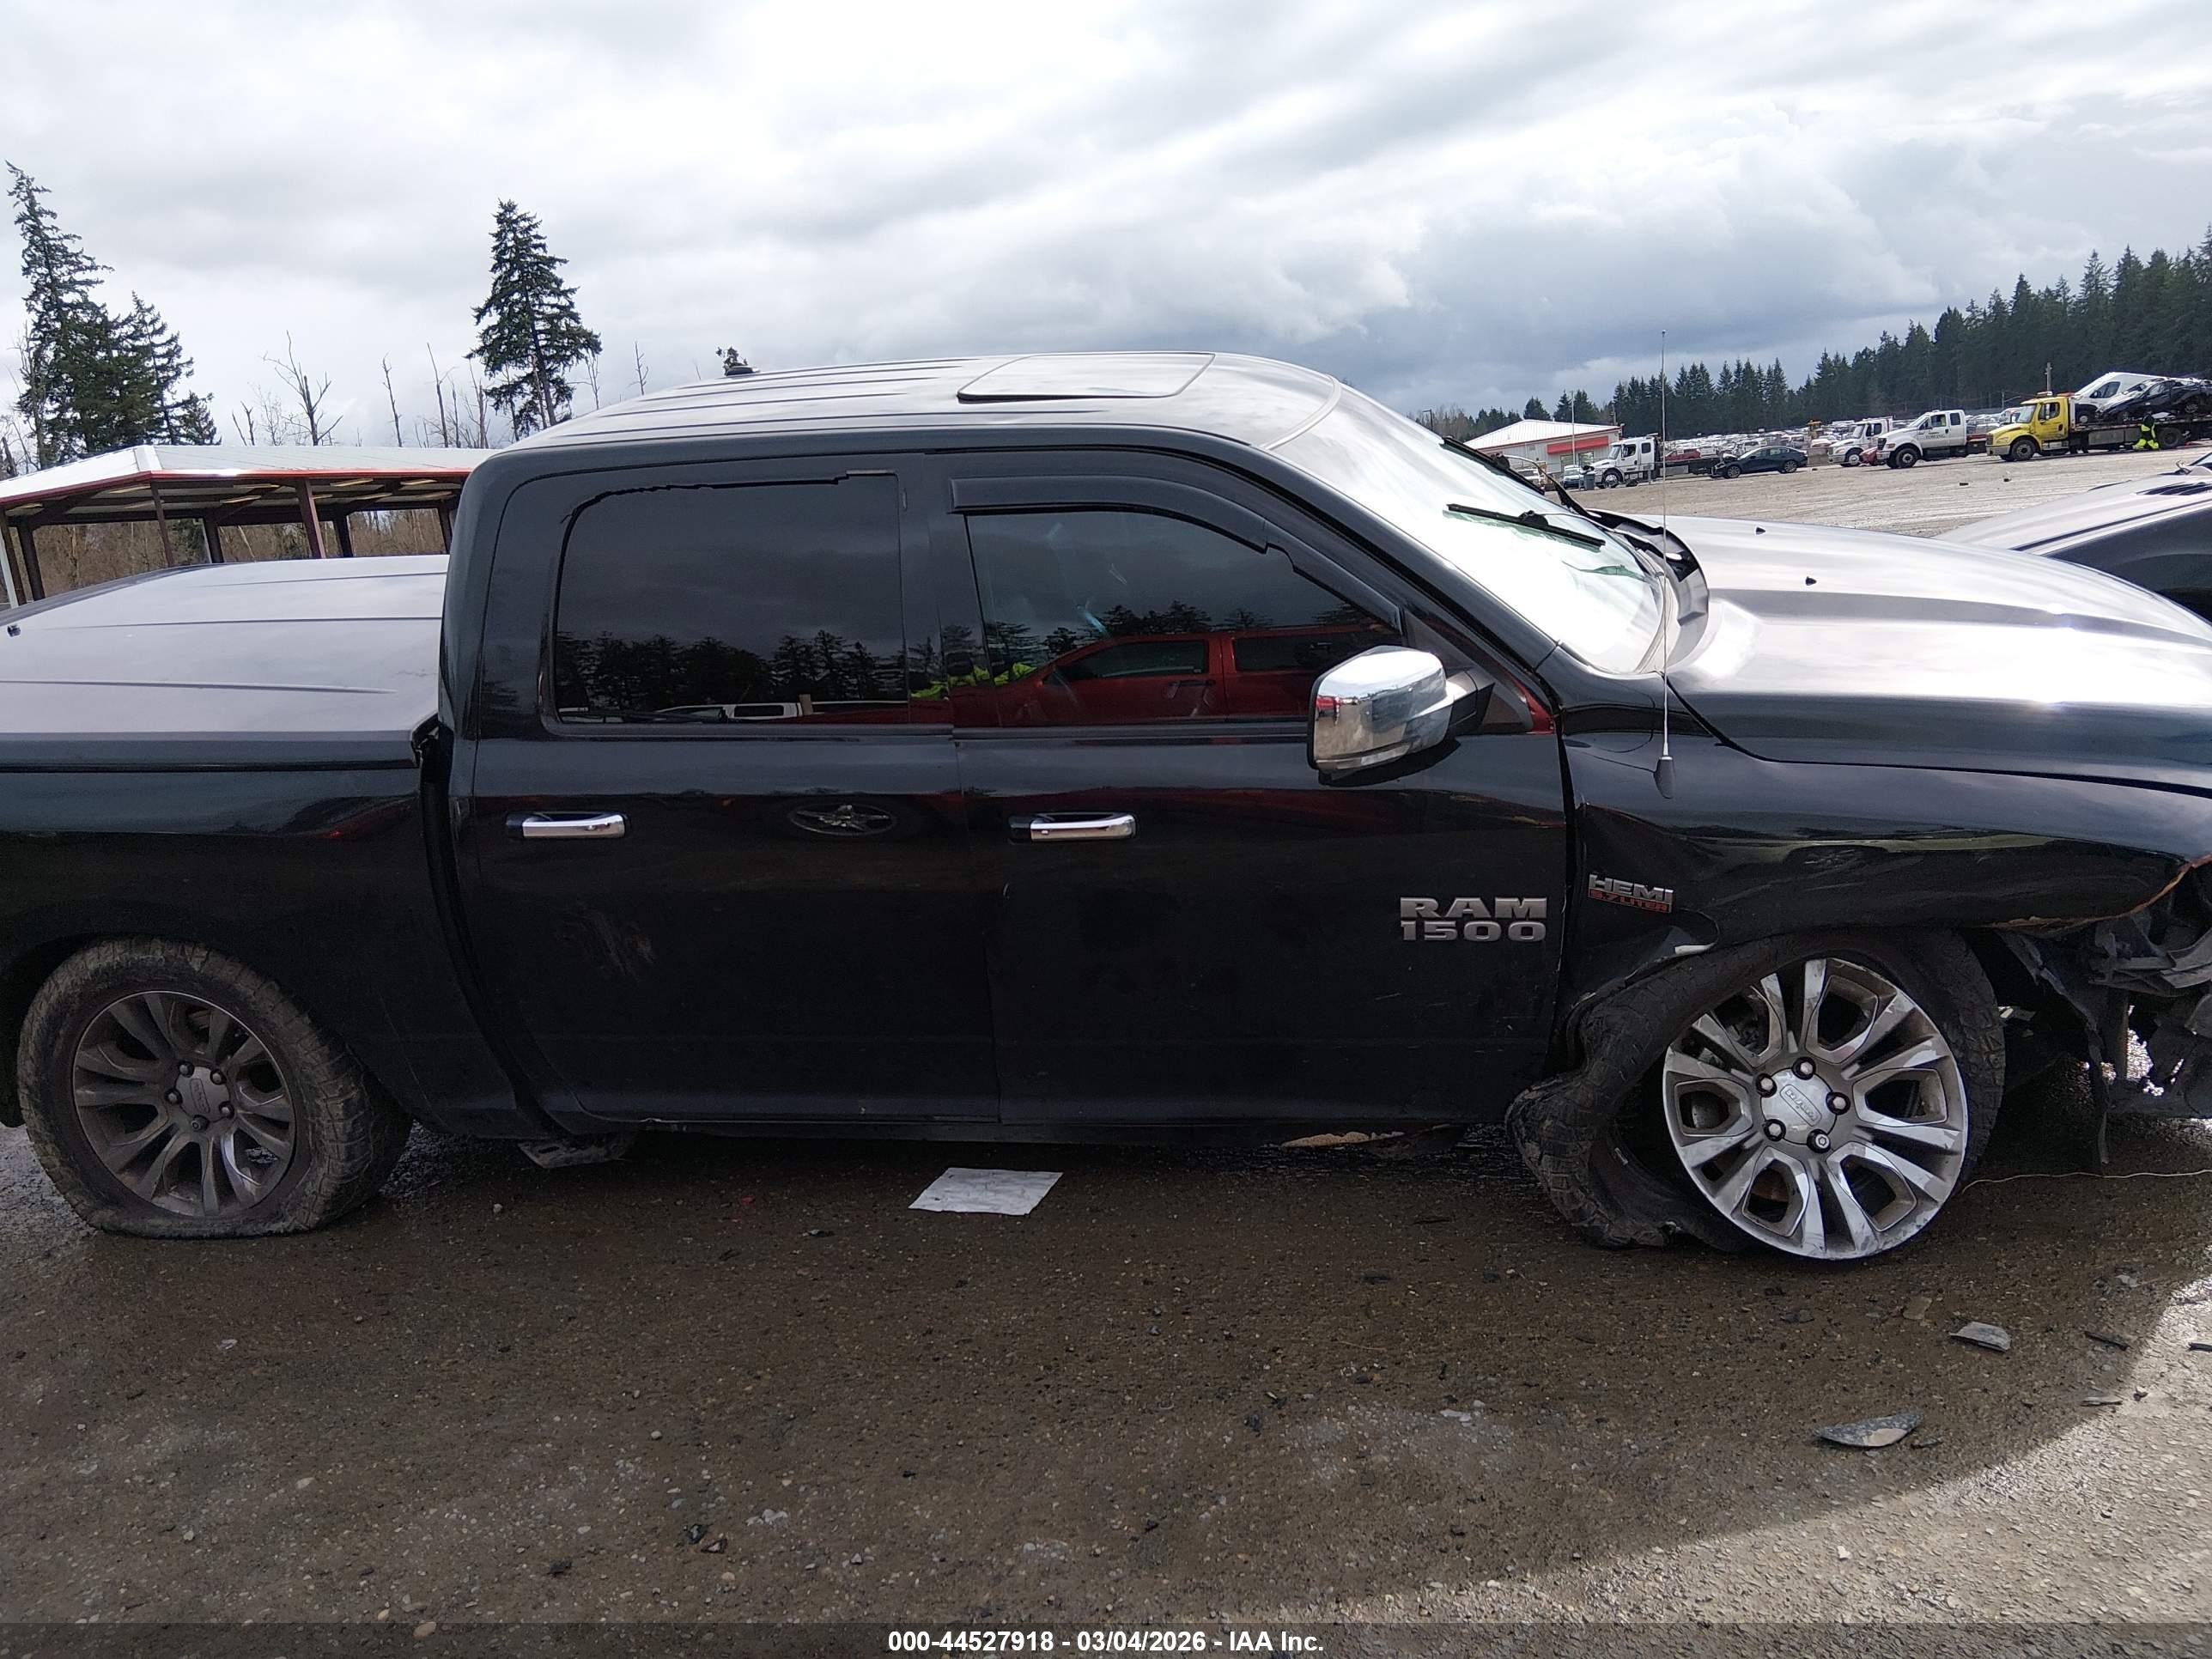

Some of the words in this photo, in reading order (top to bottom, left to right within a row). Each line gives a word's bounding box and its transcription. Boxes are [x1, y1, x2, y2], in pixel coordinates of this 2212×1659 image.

[1589, 873, 1674, 902] HEMI
[1400, 896, 1547, 919] RAM
[1401, 921, 1547, 942] 1500
